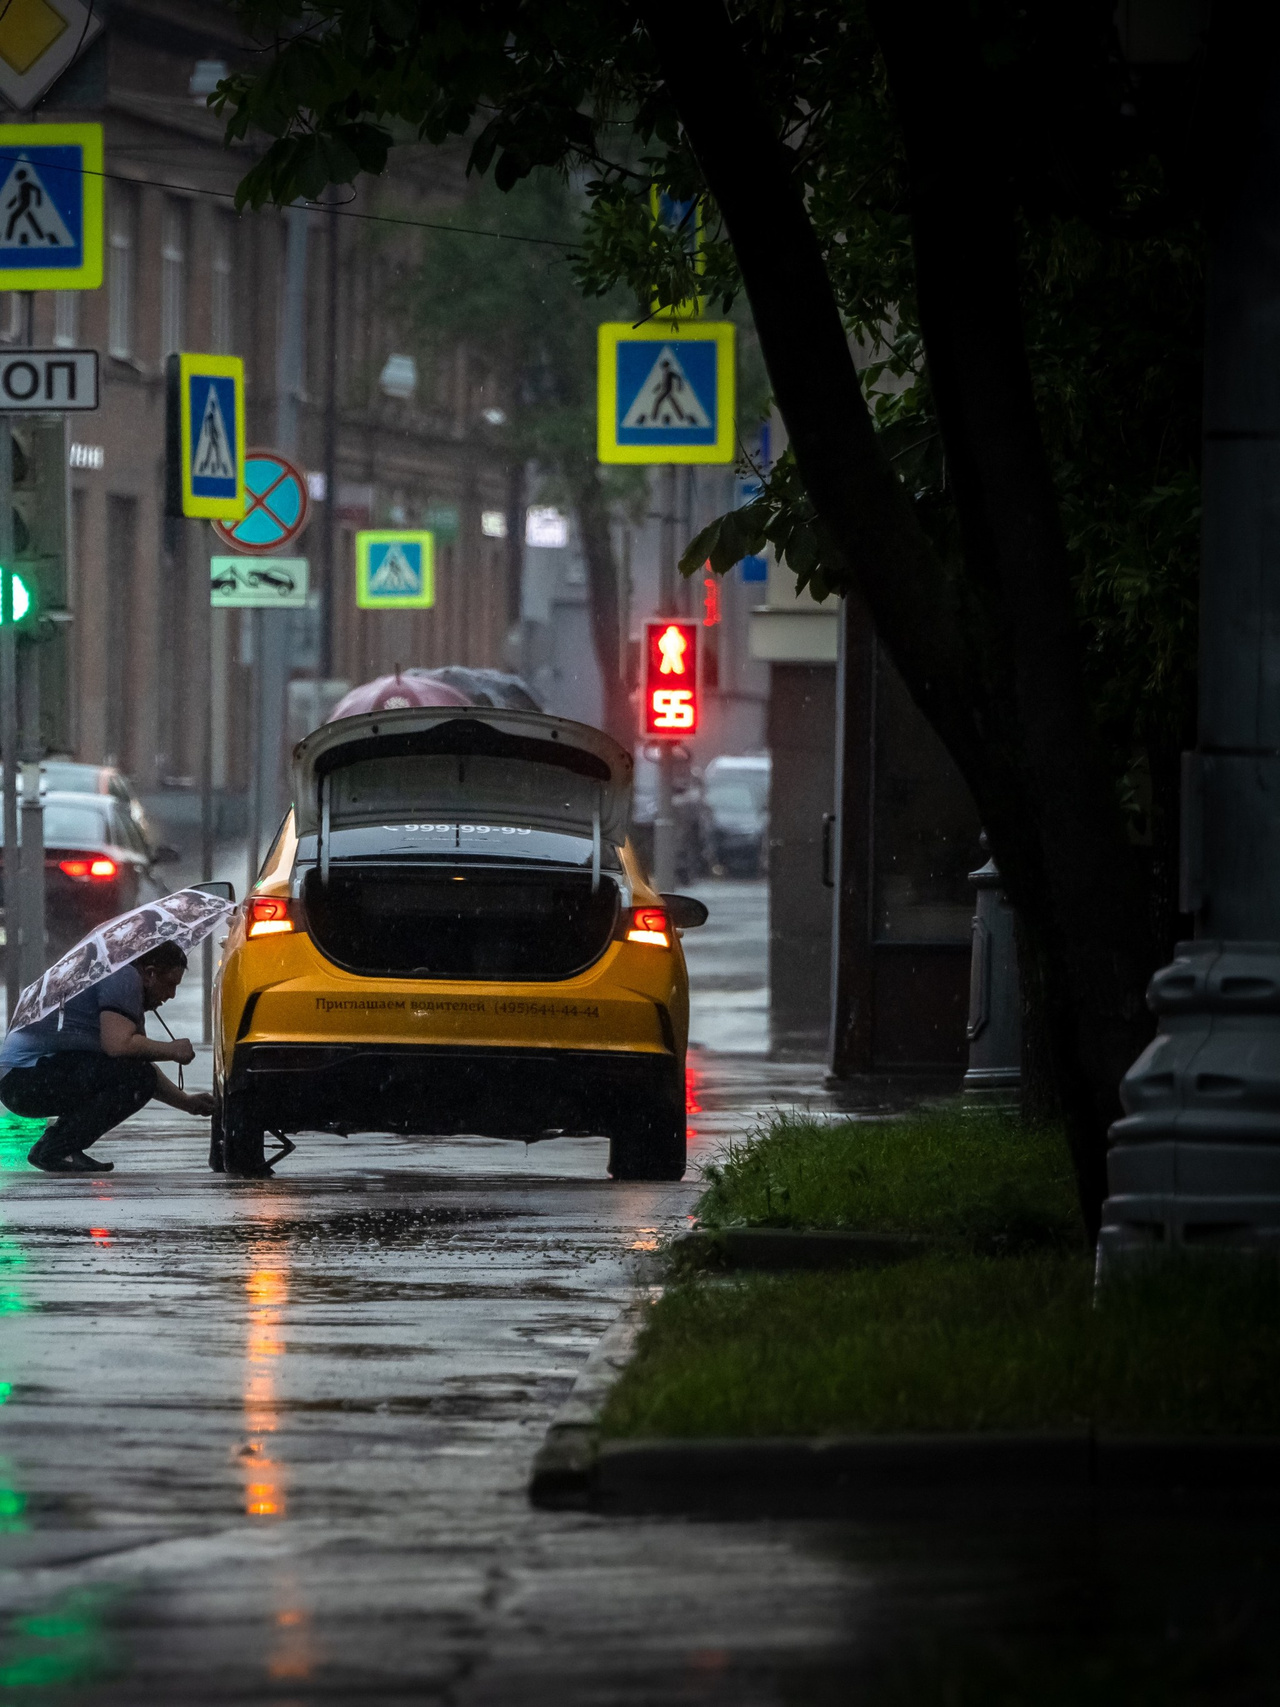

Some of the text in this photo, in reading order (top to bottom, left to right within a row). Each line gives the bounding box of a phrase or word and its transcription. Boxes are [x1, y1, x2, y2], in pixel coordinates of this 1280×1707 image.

[653, 690, 694, 727] 55
[315, 997, 600, 1018] Приглашаем водителей (495)644-44-44
